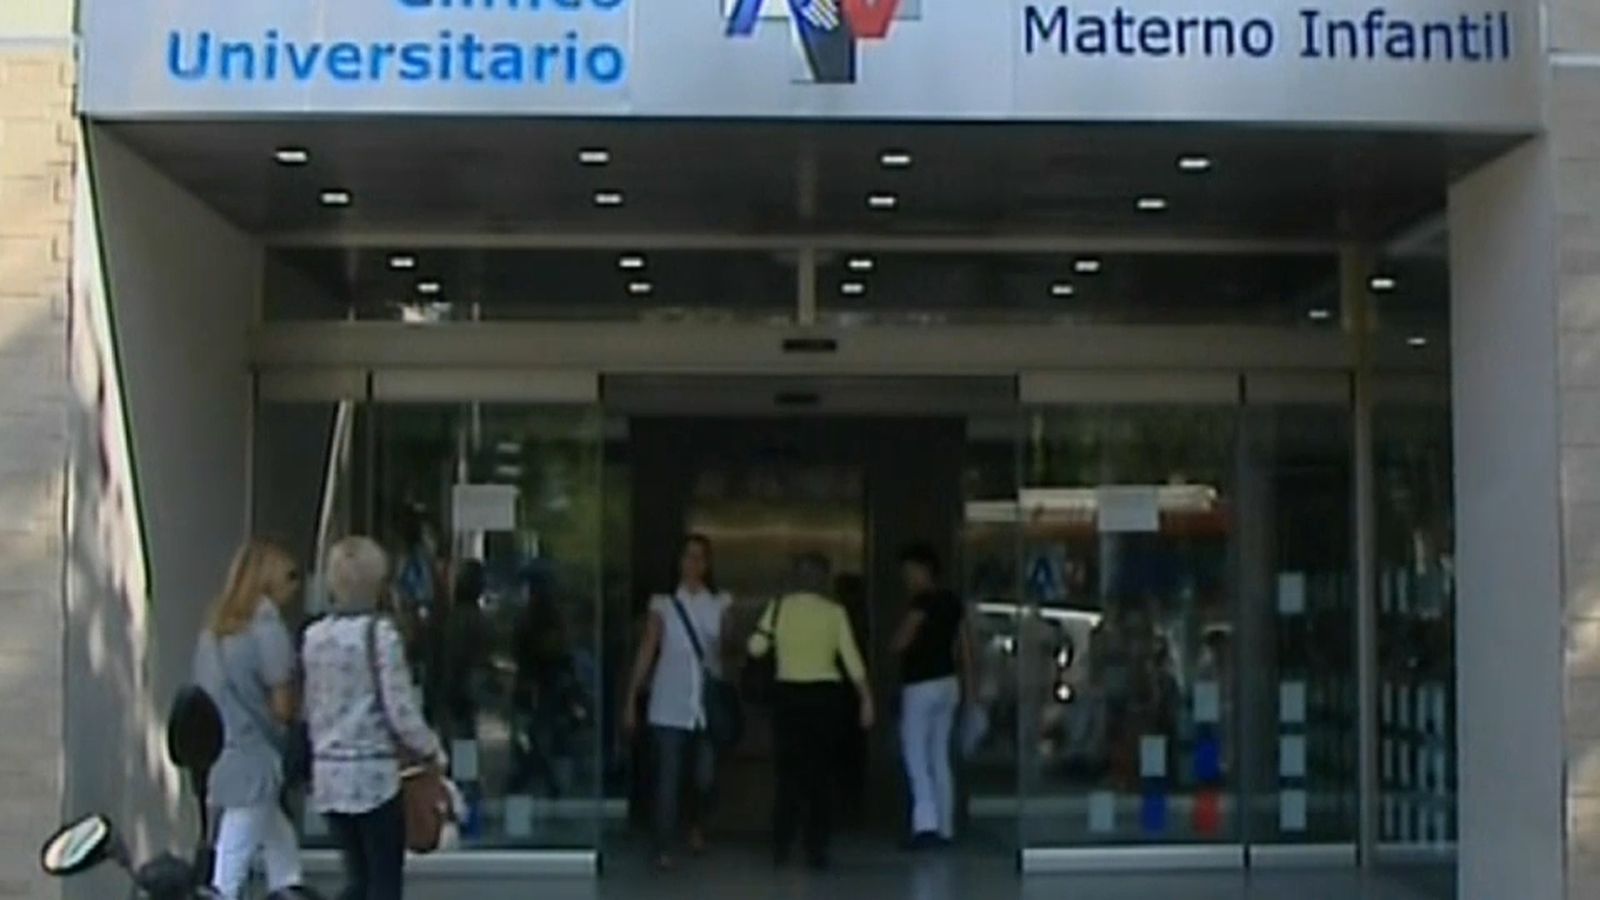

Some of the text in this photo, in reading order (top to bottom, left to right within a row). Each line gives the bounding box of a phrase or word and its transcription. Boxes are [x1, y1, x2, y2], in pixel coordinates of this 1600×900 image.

[167, 31, 624, 84] Universitario
[1024, 6, 1510, 61] Materno Infantil
